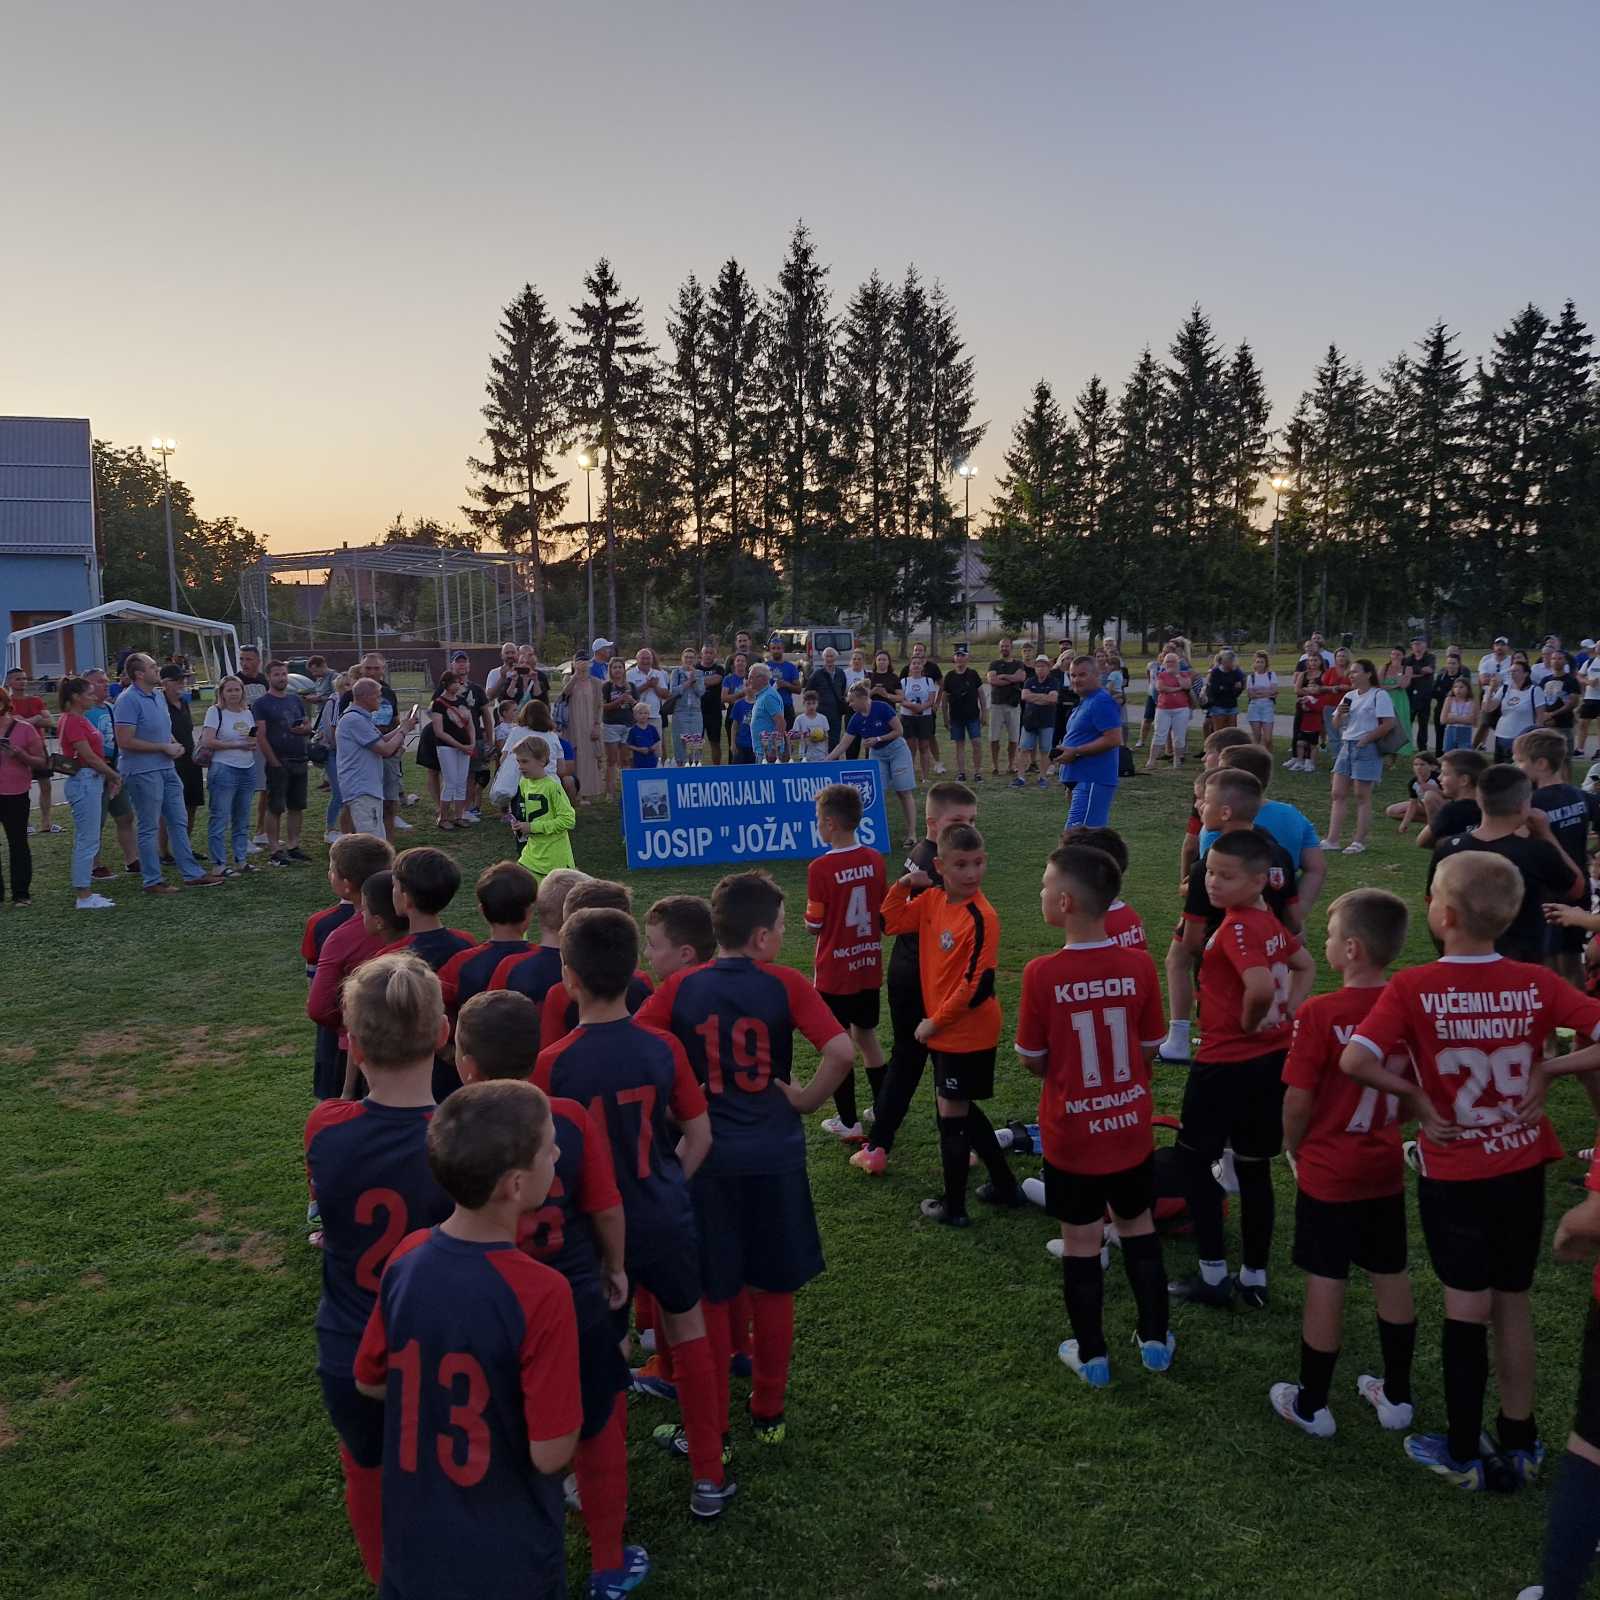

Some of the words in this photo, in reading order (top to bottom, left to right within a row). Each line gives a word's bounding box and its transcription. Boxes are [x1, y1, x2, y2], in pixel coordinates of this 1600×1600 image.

[676, 780, 775, 809] MEMORIJALNI
[637, 826, 713, 861] JOSIP
[810, 816, 876, 849] KS
[834, 864, 874, 885] UZUN
[845, 885, 872, 937] 4
[1054, 977, 1137, 1004] KOSOR
[1420, 982, 1544, 1015] VUČEMILOVIĆ
[1071, 1006, 1132, 1089] 11
[1435, 1011, 1535, 1040] ŠIMUNOVIĆ
[695, 1013, 772, 1095] 19
[1435, 1041, 1535, 1128] 29
[1089, 1111, 1139, 1135] KNIN
[354, 1188, 409, 1297] 2
[388, 1338, 492, 1488] 13
